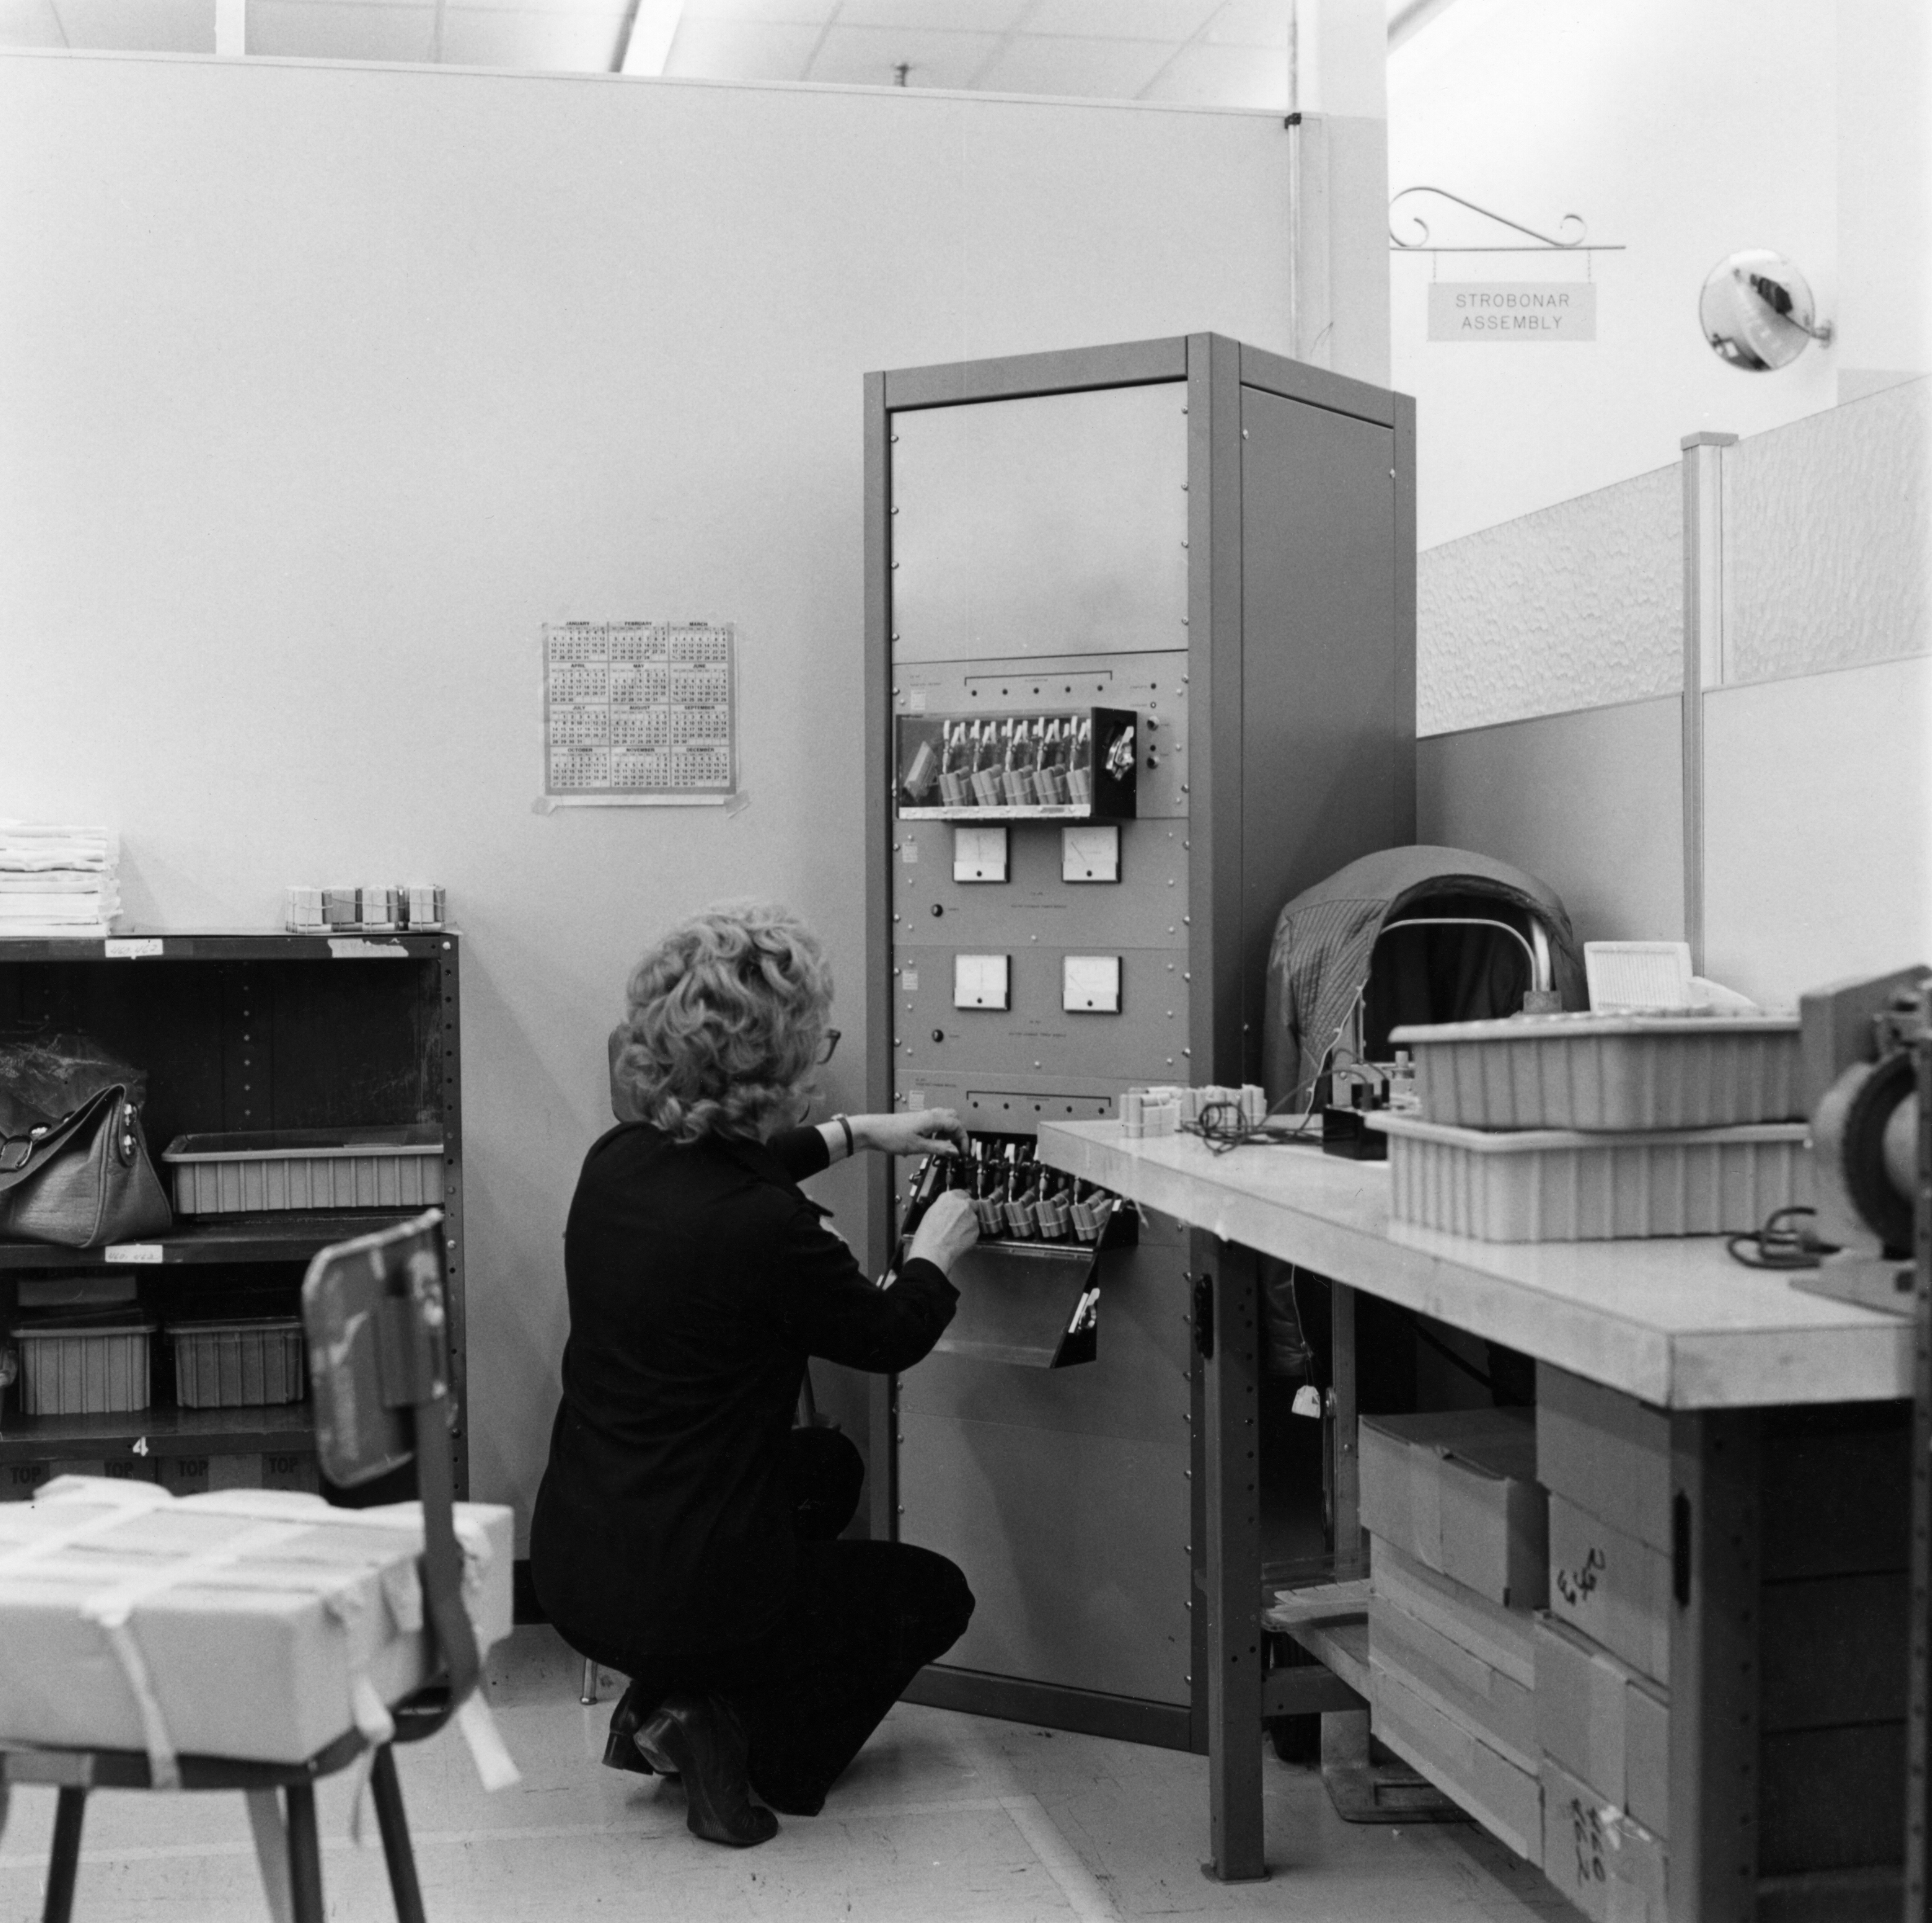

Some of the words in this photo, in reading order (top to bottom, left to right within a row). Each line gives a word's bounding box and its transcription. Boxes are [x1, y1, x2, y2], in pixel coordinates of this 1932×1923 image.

[1456, 293, 1569, 307] STROBONAR
[1462, 315, 1563, 330] ASSEMBLY
[133, 1436, 148, 1456] 4
[104, 1462, 134, 1477] TOP
[179, 1461, 208, 1476] TOP
[269, 1458, 298, 1473] TOP
[11, 1467, 41, 1484] TOP
